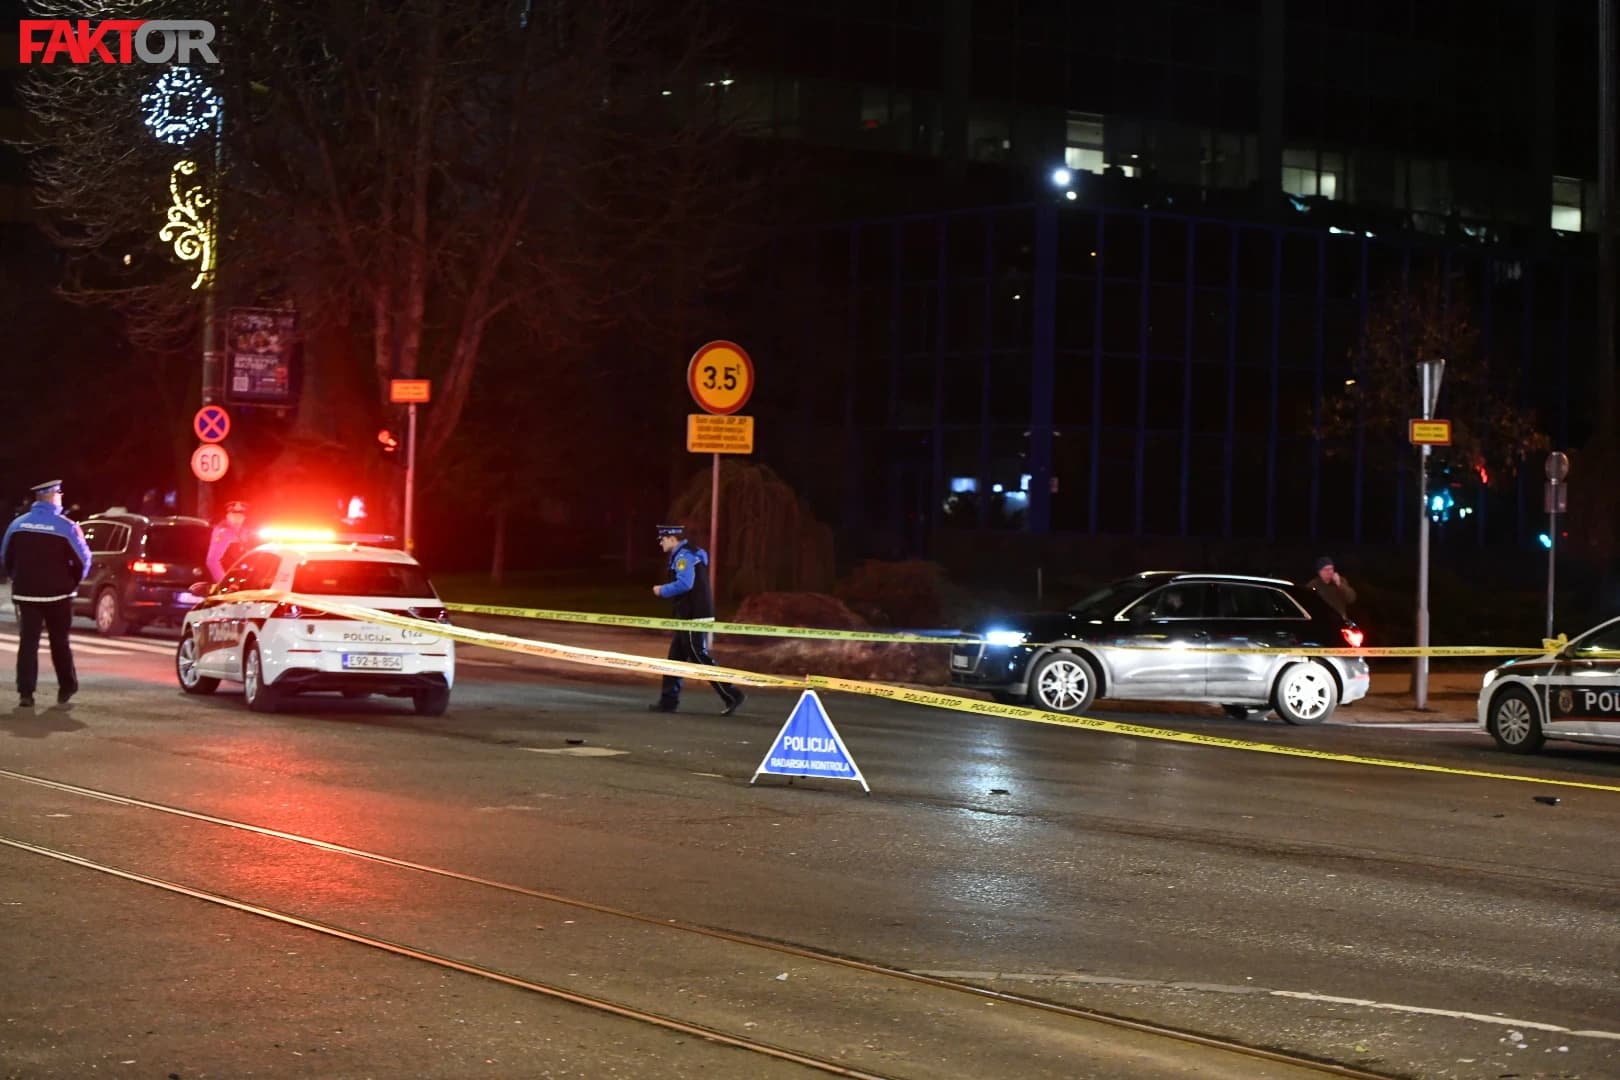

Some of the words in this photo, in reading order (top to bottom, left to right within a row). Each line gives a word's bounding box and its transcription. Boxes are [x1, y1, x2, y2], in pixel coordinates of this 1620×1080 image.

[200, 454, 220, 472] 60
[904, 692, 939, 704] POLICIJA
[940, 698, 963, 707] STOP
[971, 703, 1007, 714] POLICIJA
[1008, 709, 1033, 717] STOP
[1040, 713, 1079, 723] POLICIJA
[1079, 719, 1105, 727] STOP
[783, 736, 838, 754] POLICIJA
[771, 757, 810, 769] RADARSKA
